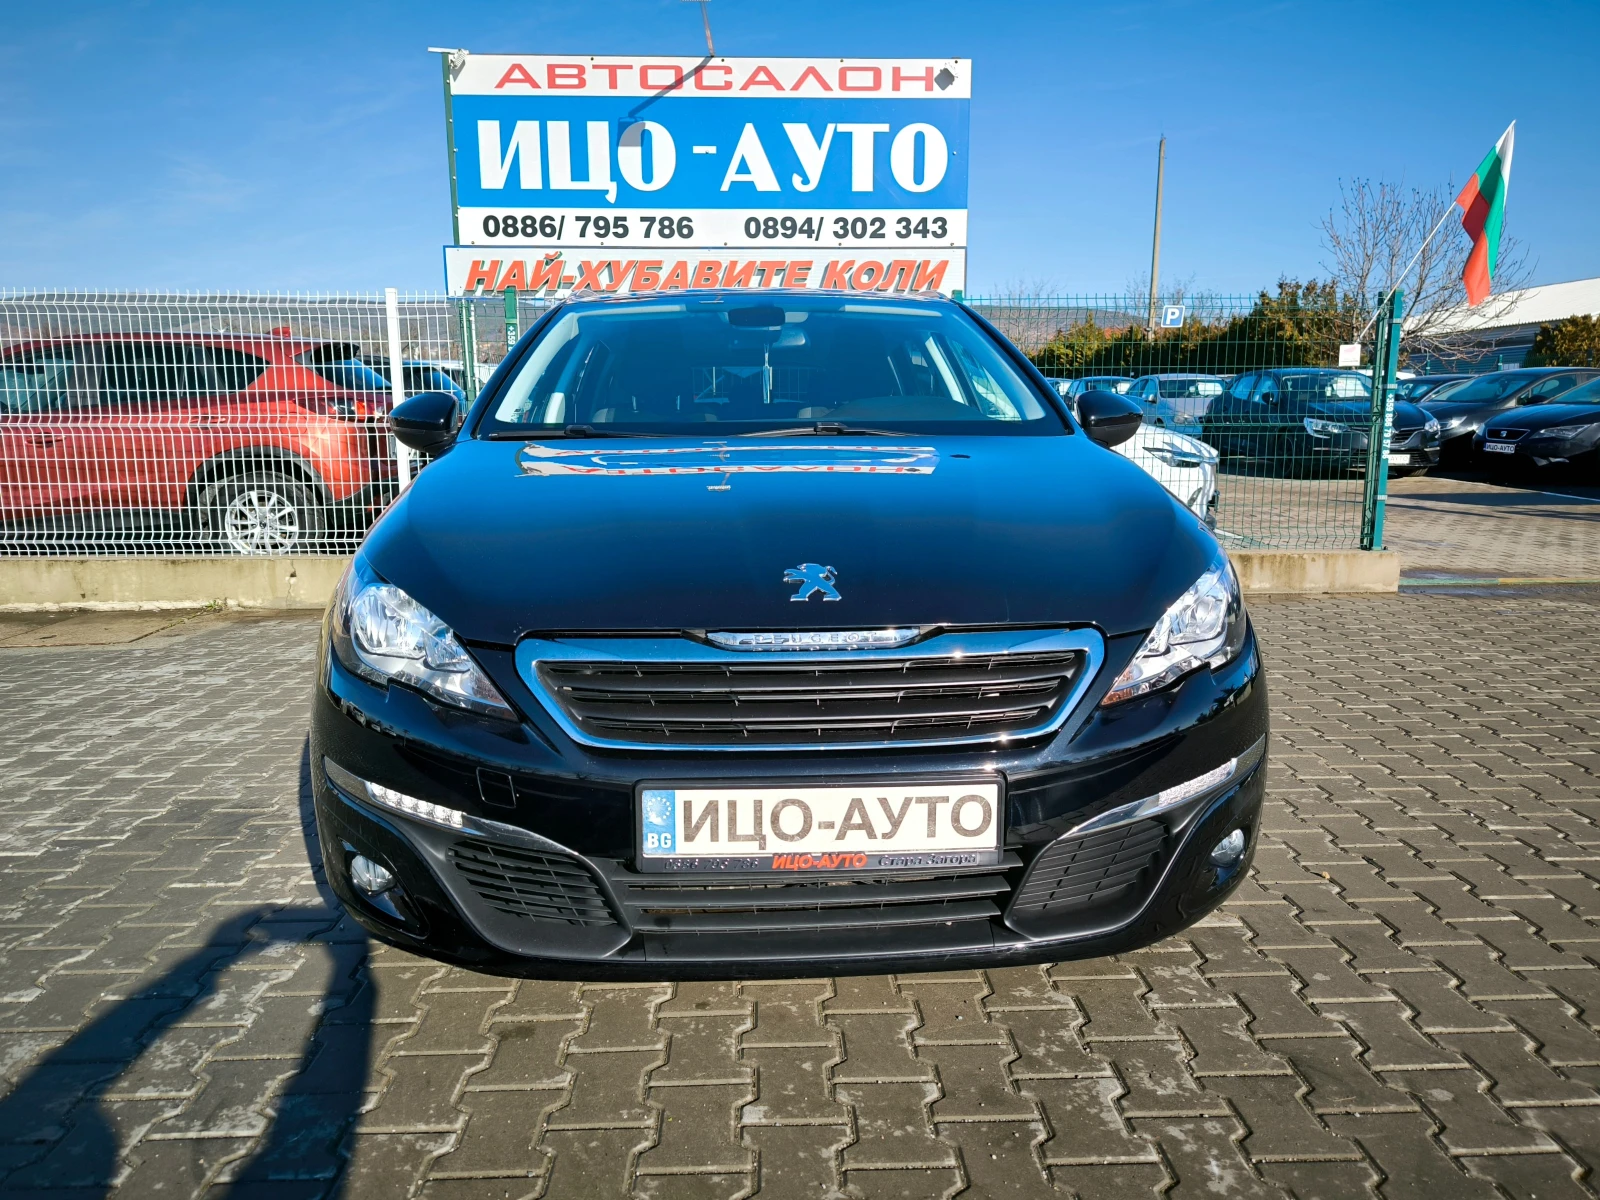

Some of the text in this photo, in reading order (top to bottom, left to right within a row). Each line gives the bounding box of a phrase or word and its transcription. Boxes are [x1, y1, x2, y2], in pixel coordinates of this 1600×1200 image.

[494, 63, 934, 92] АВТОСАЛОН
[483, 215, 694, 240] 0886/ 795 786
[744, 216, 948, 241] 0894/ 302 343
[464, 251, 949, 291] НАЙ-ХУБАВИТЕ КОЛИ
[1166, 308, 1180, 325] P
[752, 632, 878, 644] PEUGEOT
[683, 794, 992, 851] ИЦО-АУТО
[647, 832, 672, 849] BG
[772, 852, 867, 871] ИЦО-АУТО
